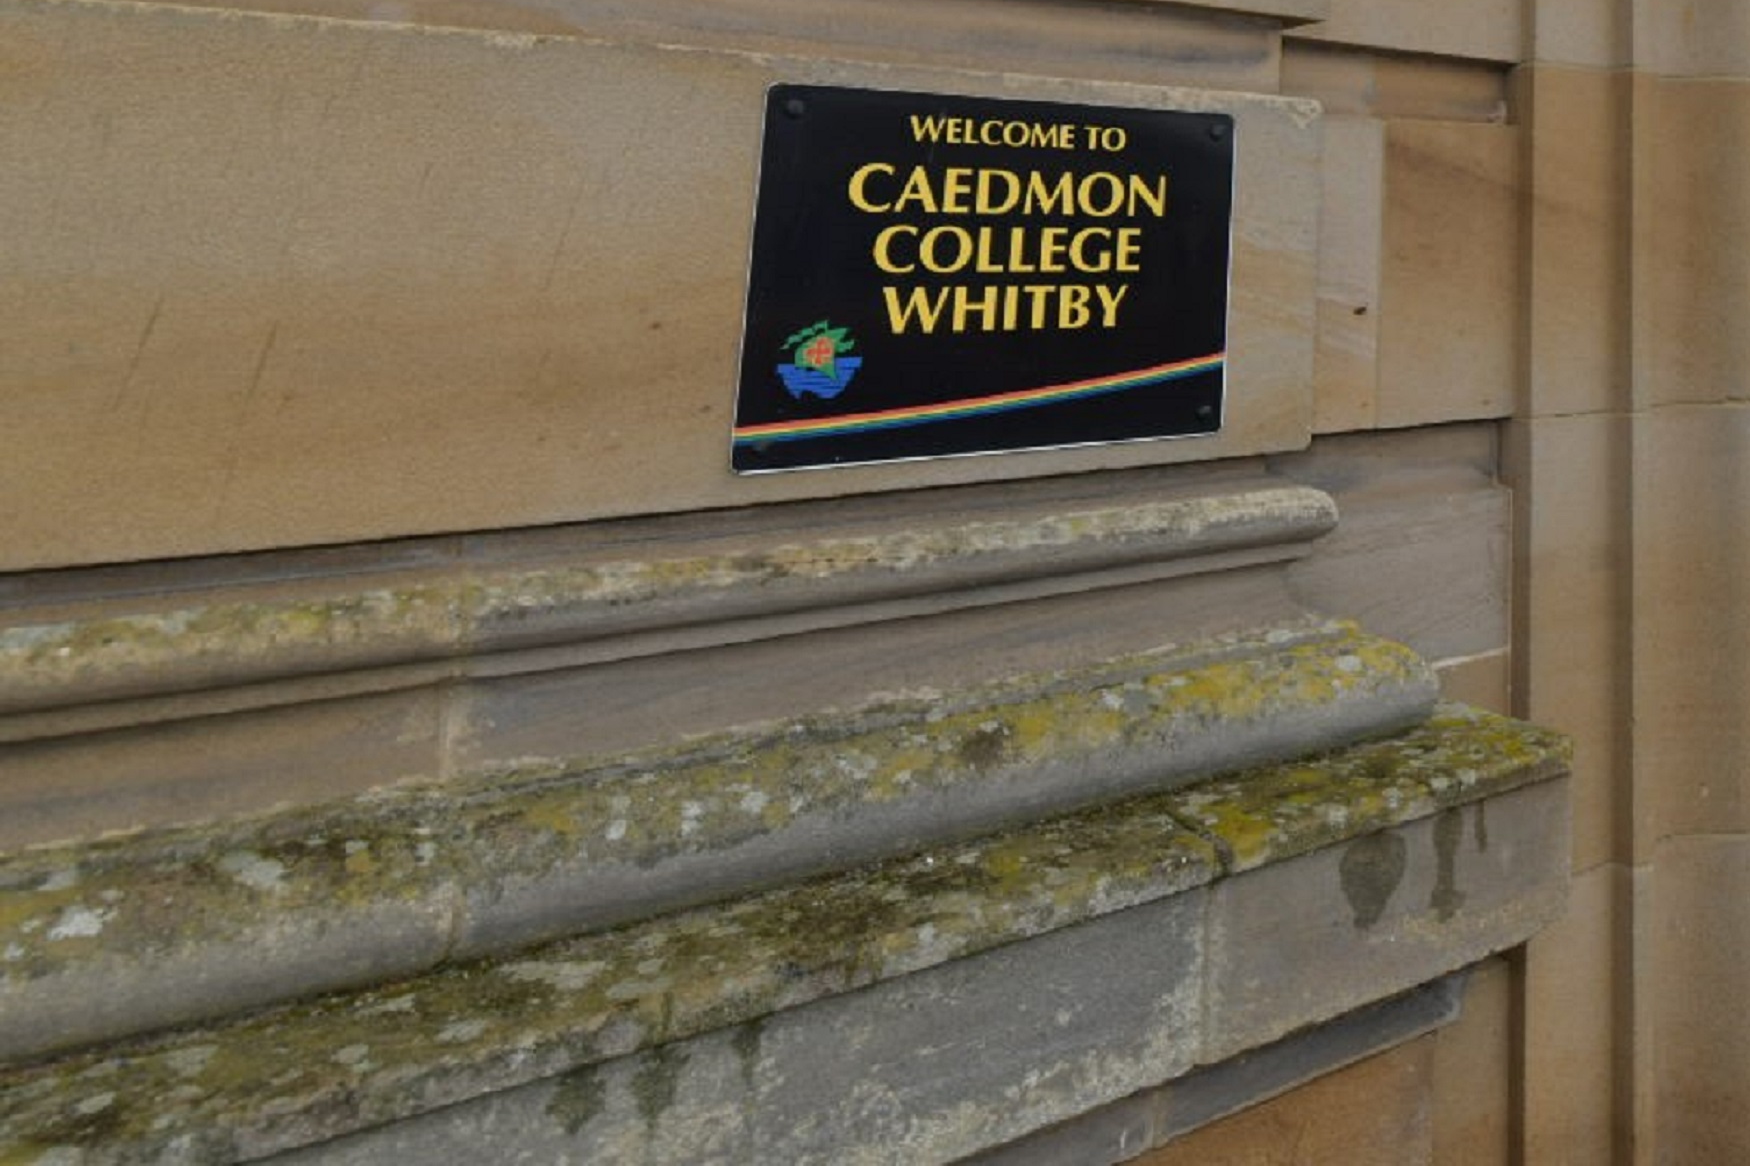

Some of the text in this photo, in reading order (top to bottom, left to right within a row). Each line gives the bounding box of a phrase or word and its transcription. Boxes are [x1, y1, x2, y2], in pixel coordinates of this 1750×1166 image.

[910, 115, 1127, 152] WELCOME TO
[848, 162, 1166, 217] CAEDMON
[872, 225, 1141, 274] COLLEGE
[882, 284, 1129, 334] WHITBY
